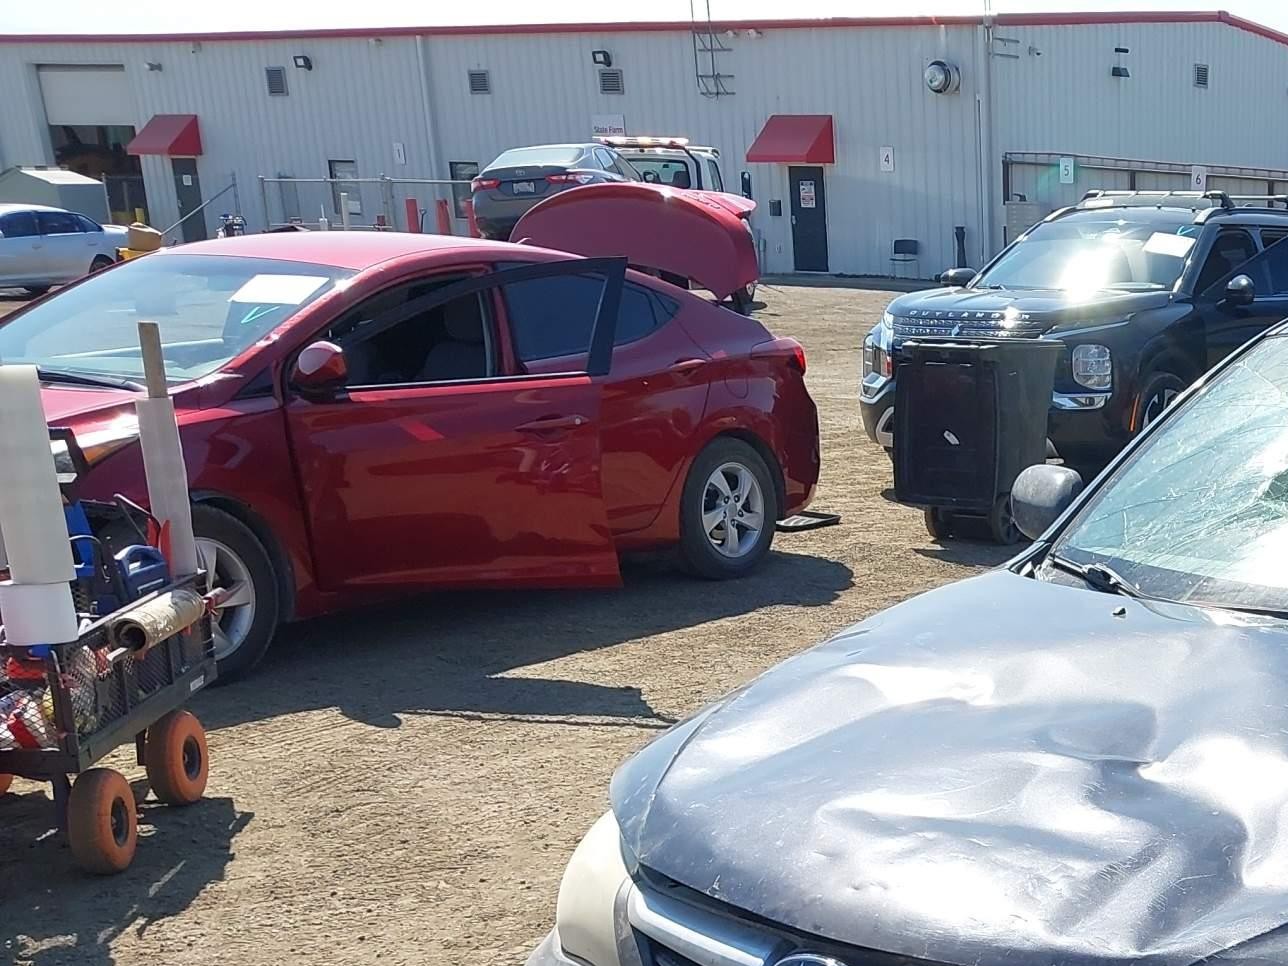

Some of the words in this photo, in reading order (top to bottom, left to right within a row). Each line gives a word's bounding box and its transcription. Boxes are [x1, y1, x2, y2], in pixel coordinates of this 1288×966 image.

[884, 153, 890, 165] 4
[1064, 164, 1070, 177] 5
[1195, 174, 1202, 185] 6
